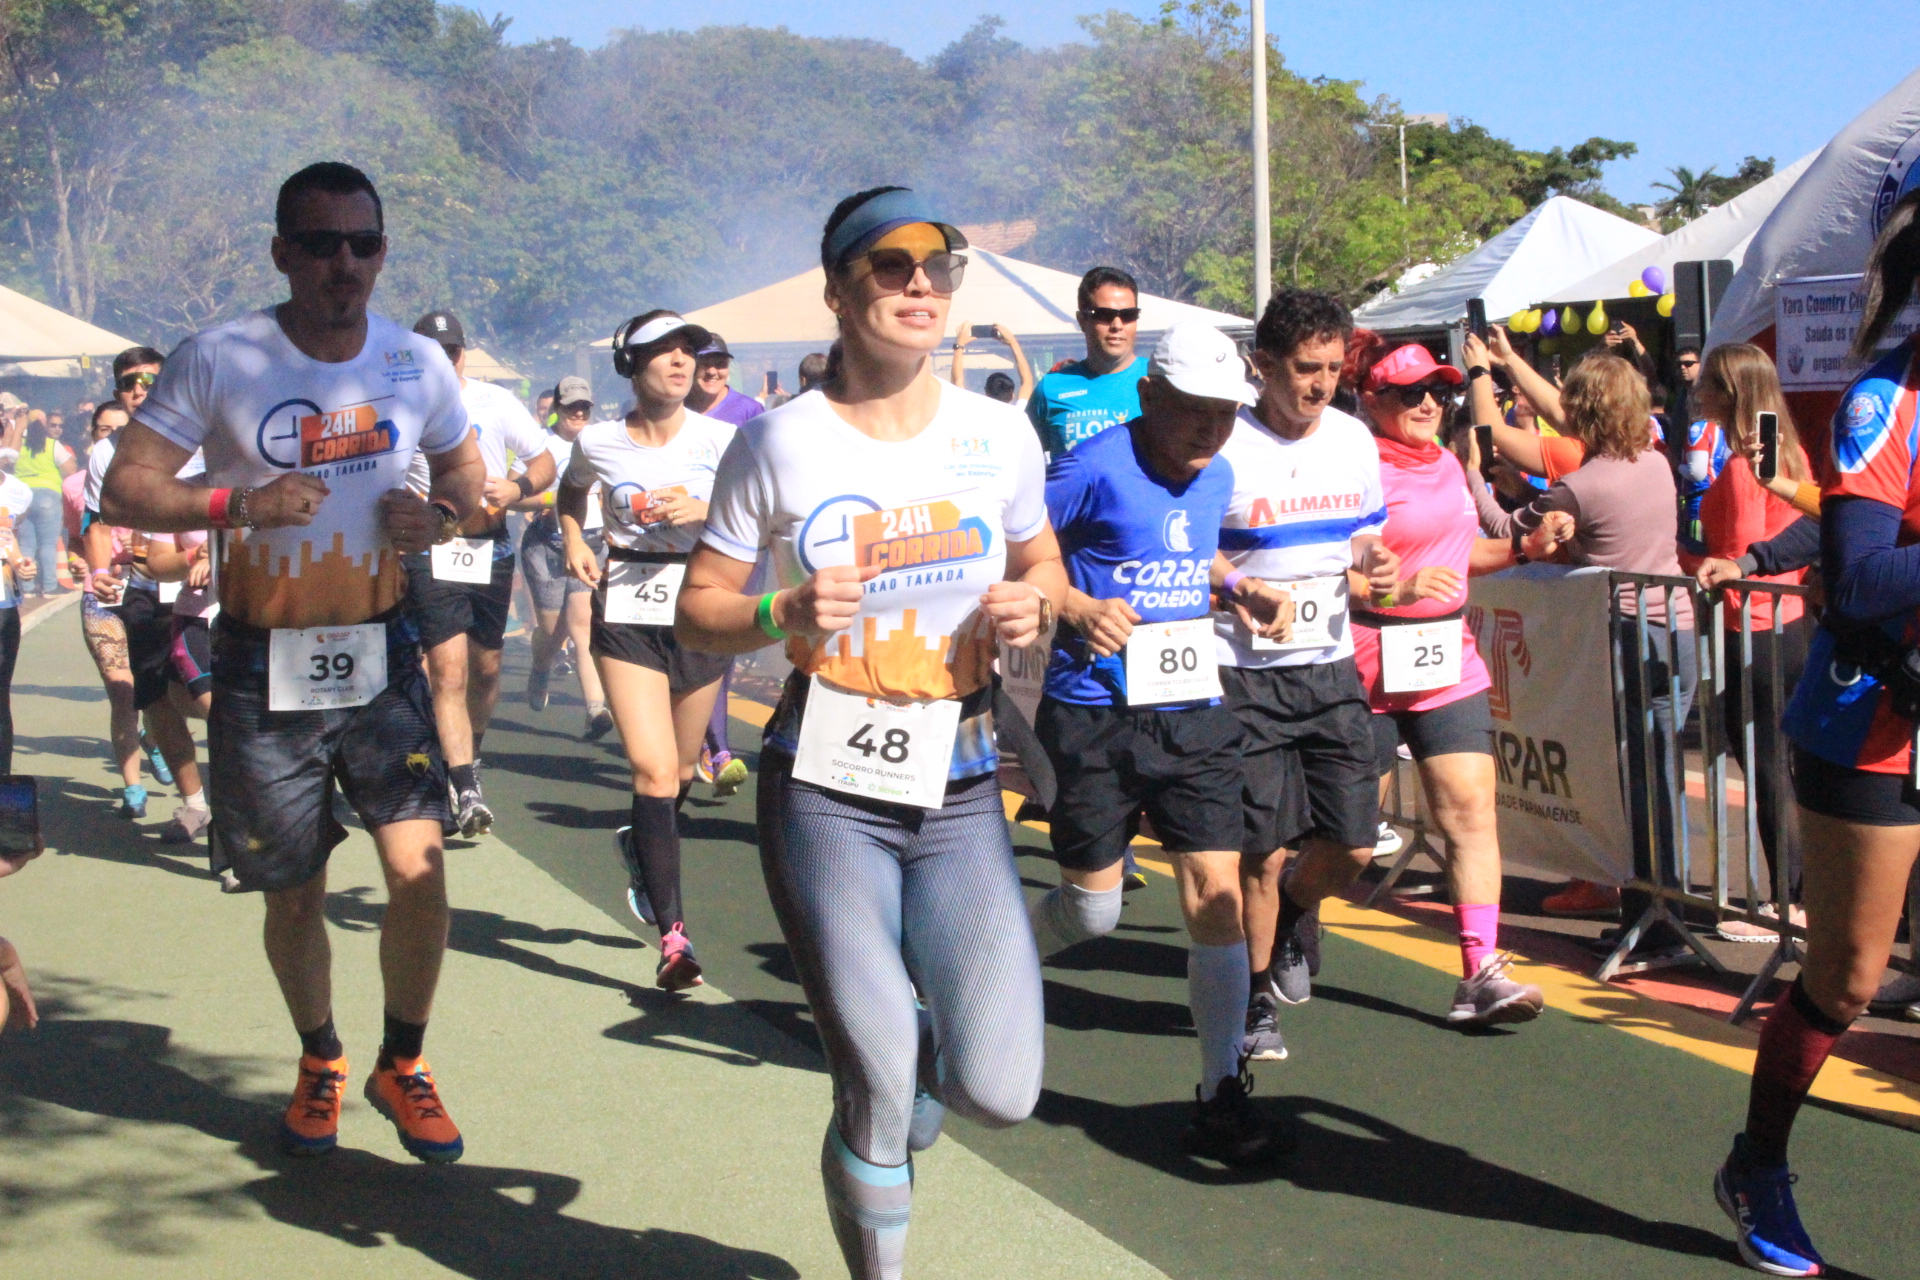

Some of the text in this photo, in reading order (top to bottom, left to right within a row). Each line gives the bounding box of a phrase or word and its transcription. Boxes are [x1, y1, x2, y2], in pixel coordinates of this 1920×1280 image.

[1782, 296, 1804, 315] Yara
[1806, 293, 1847, 314] Country
[321, 410, 357, 439] 24H
[1066, 409, 1109, 418] MARATONA
[311, 429, 391, 463] CORRIDA
[335, 460, 378, 477] TAKADA
[881, 505, 933, 539] 24H
[1249, 493, 1361, 528] ALLMAYER
[451, 551, 474, 567] 70
[871, 527, 984, 570] CORRIDA
[906, 568, 964, 588] TAKADA
[1112, 559, 1214, 588] CORRER
[634, 583, 669, 603] 45
[1130, 589, 1203, 609] TOLEDO
[308, 652, 354, 681] 39
[1159, 646, 1198, 674] 80
[1414, 644, 1444, 668] 25
[310, 686, 336, 694] ROTARY
[847, 722, 911, 764] 48
[831, 758, 916, 782] SOCORRO RUNNERS
[837, 779, 860, 788] ITAIPU
